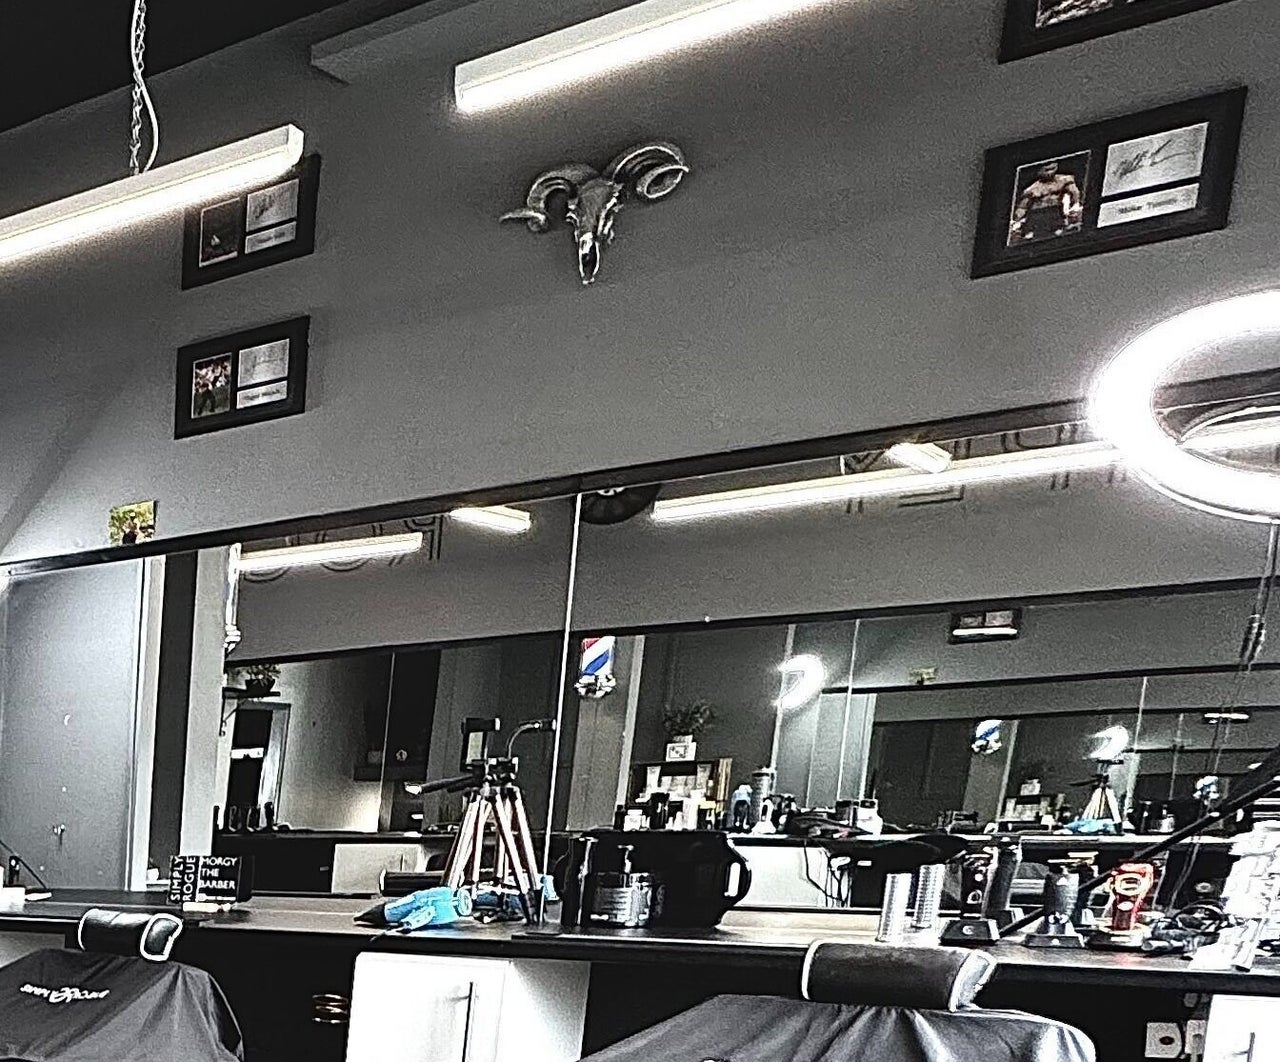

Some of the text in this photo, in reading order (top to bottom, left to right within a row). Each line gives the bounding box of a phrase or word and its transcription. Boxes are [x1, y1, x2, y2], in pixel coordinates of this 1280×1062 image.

[170, 856, 184, 901] SIMPLY
[182, 856, 196, 901] ROGUE
[201, 868, 220, 877] THE
